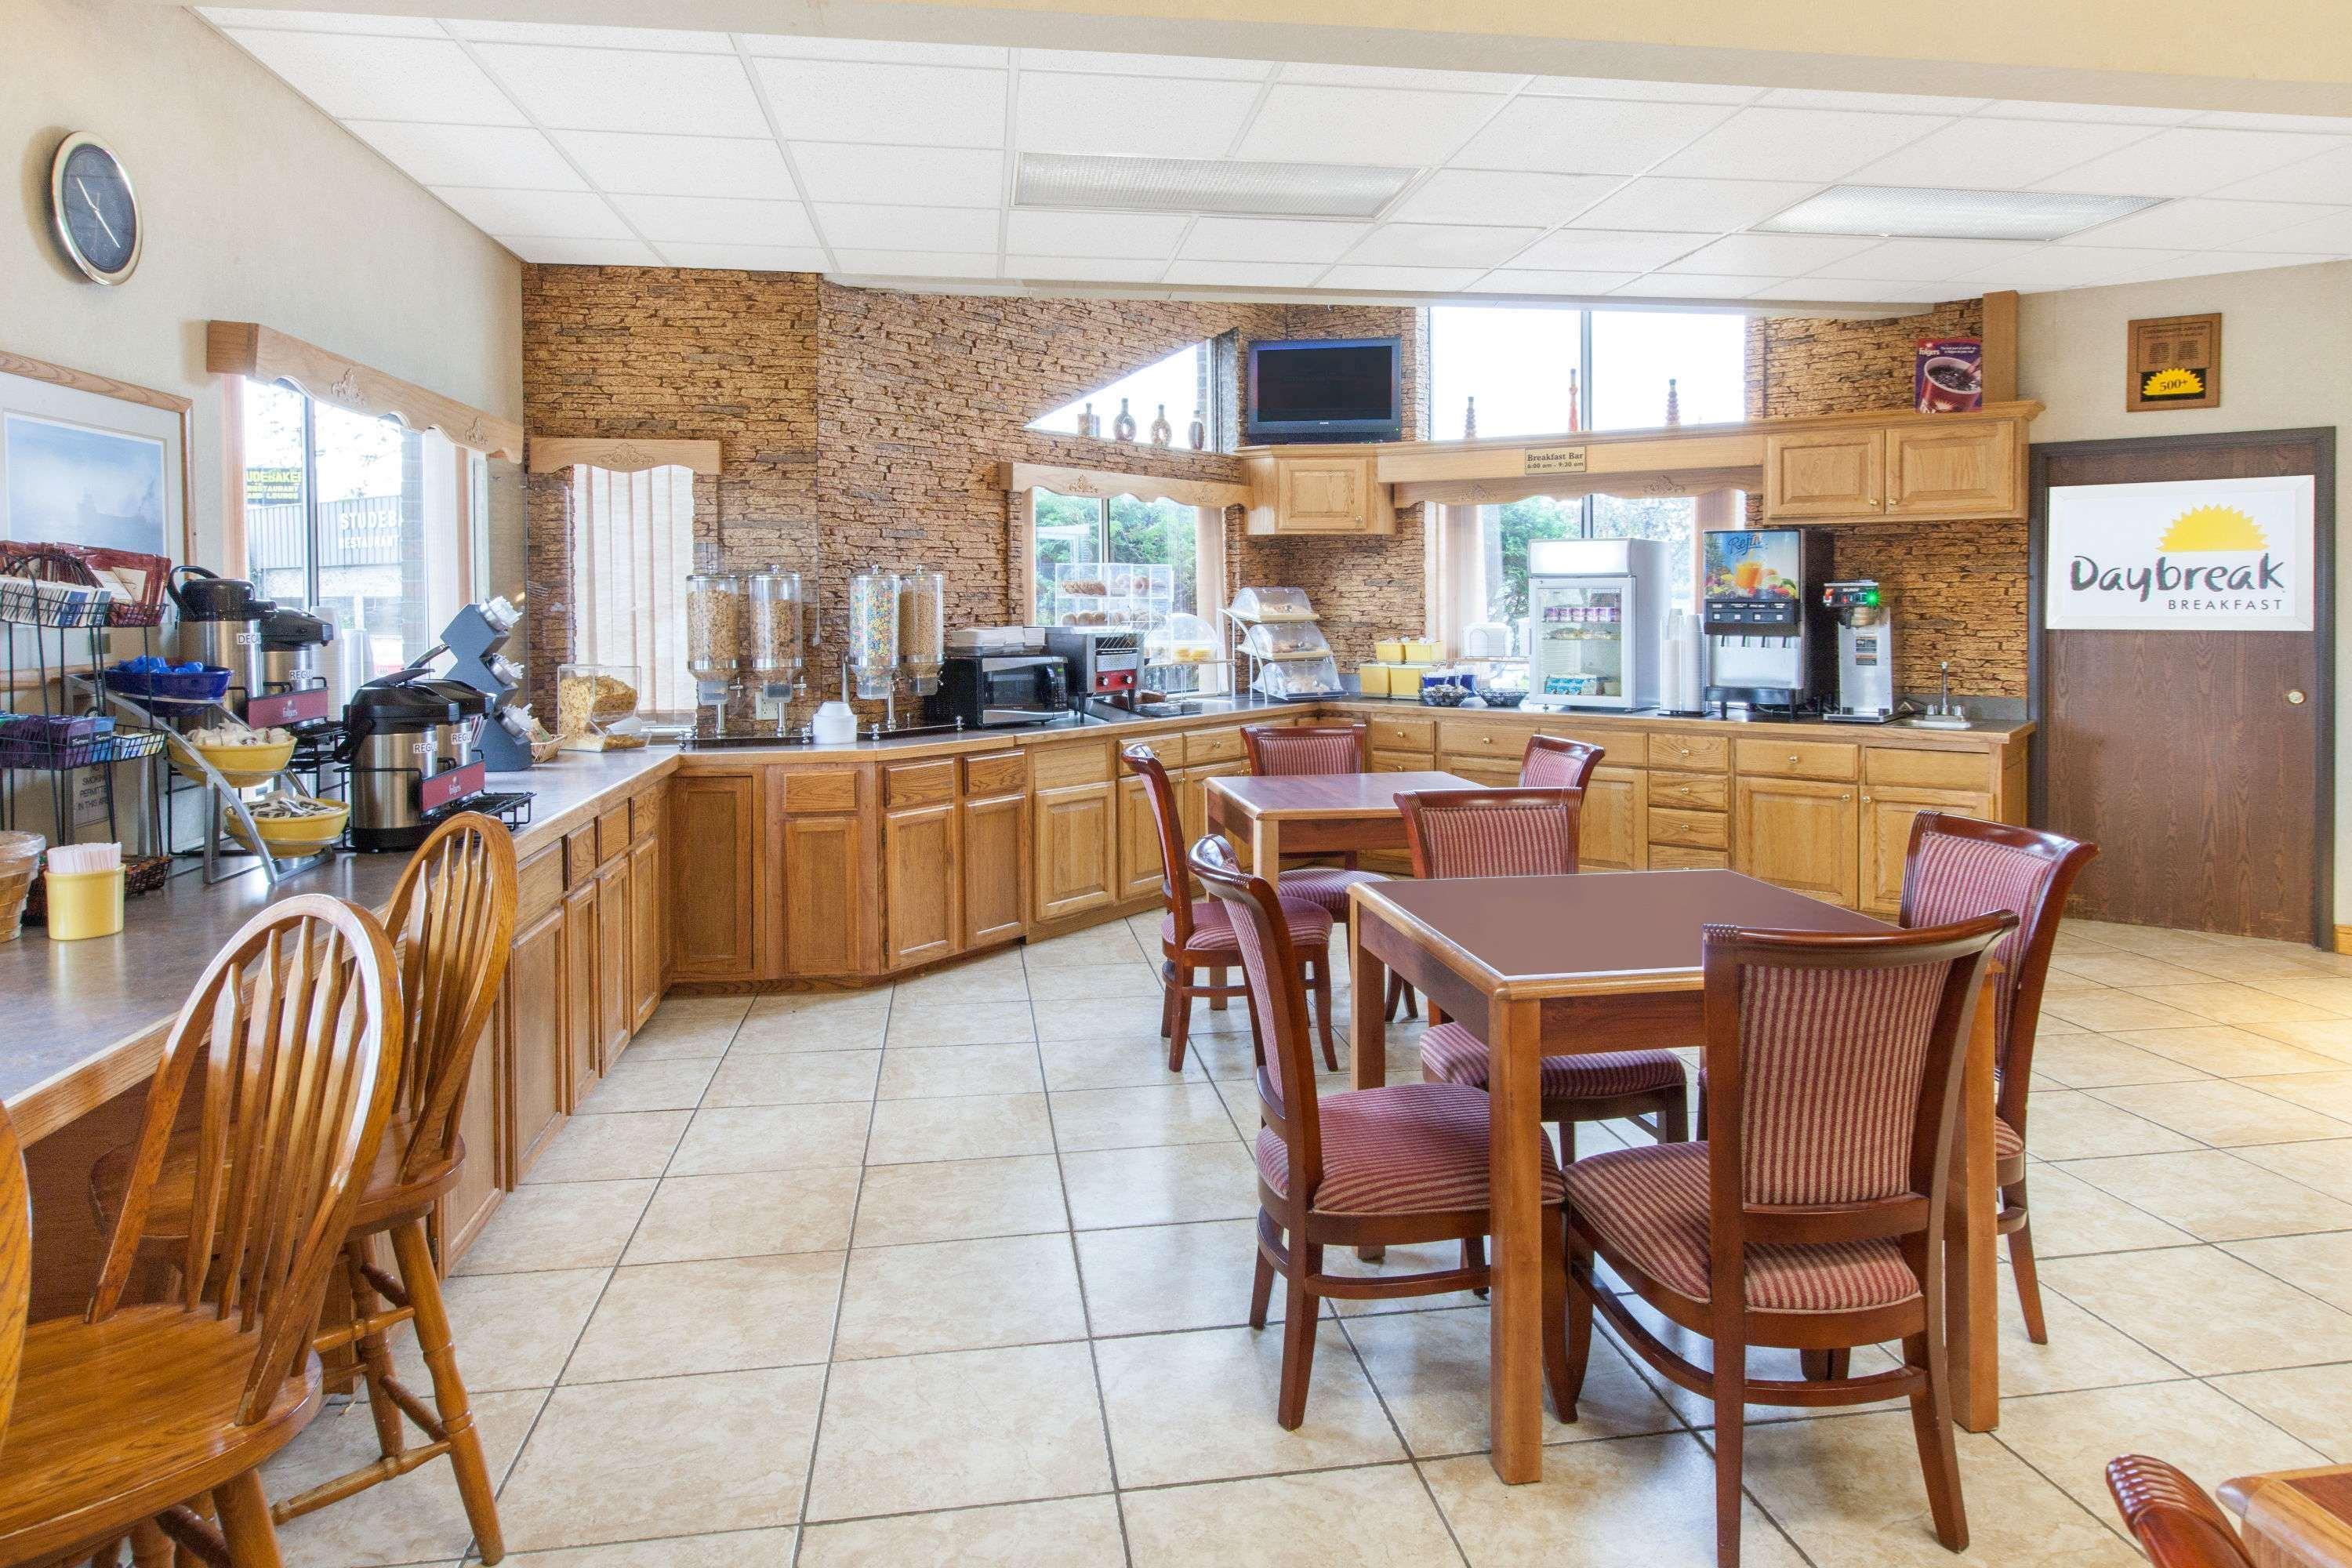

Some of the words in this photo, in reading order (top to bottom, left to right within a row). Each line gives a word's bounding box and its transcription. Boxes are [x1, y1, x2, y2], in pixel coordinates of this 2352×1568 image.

[2159, 379, 2188, 392] 500+
[246, 470, 302, 482] UDEBAKE
[2071, 553, 2284, 603] Daybreak
[2168, 599, 2283, 610] BREAKFAST
